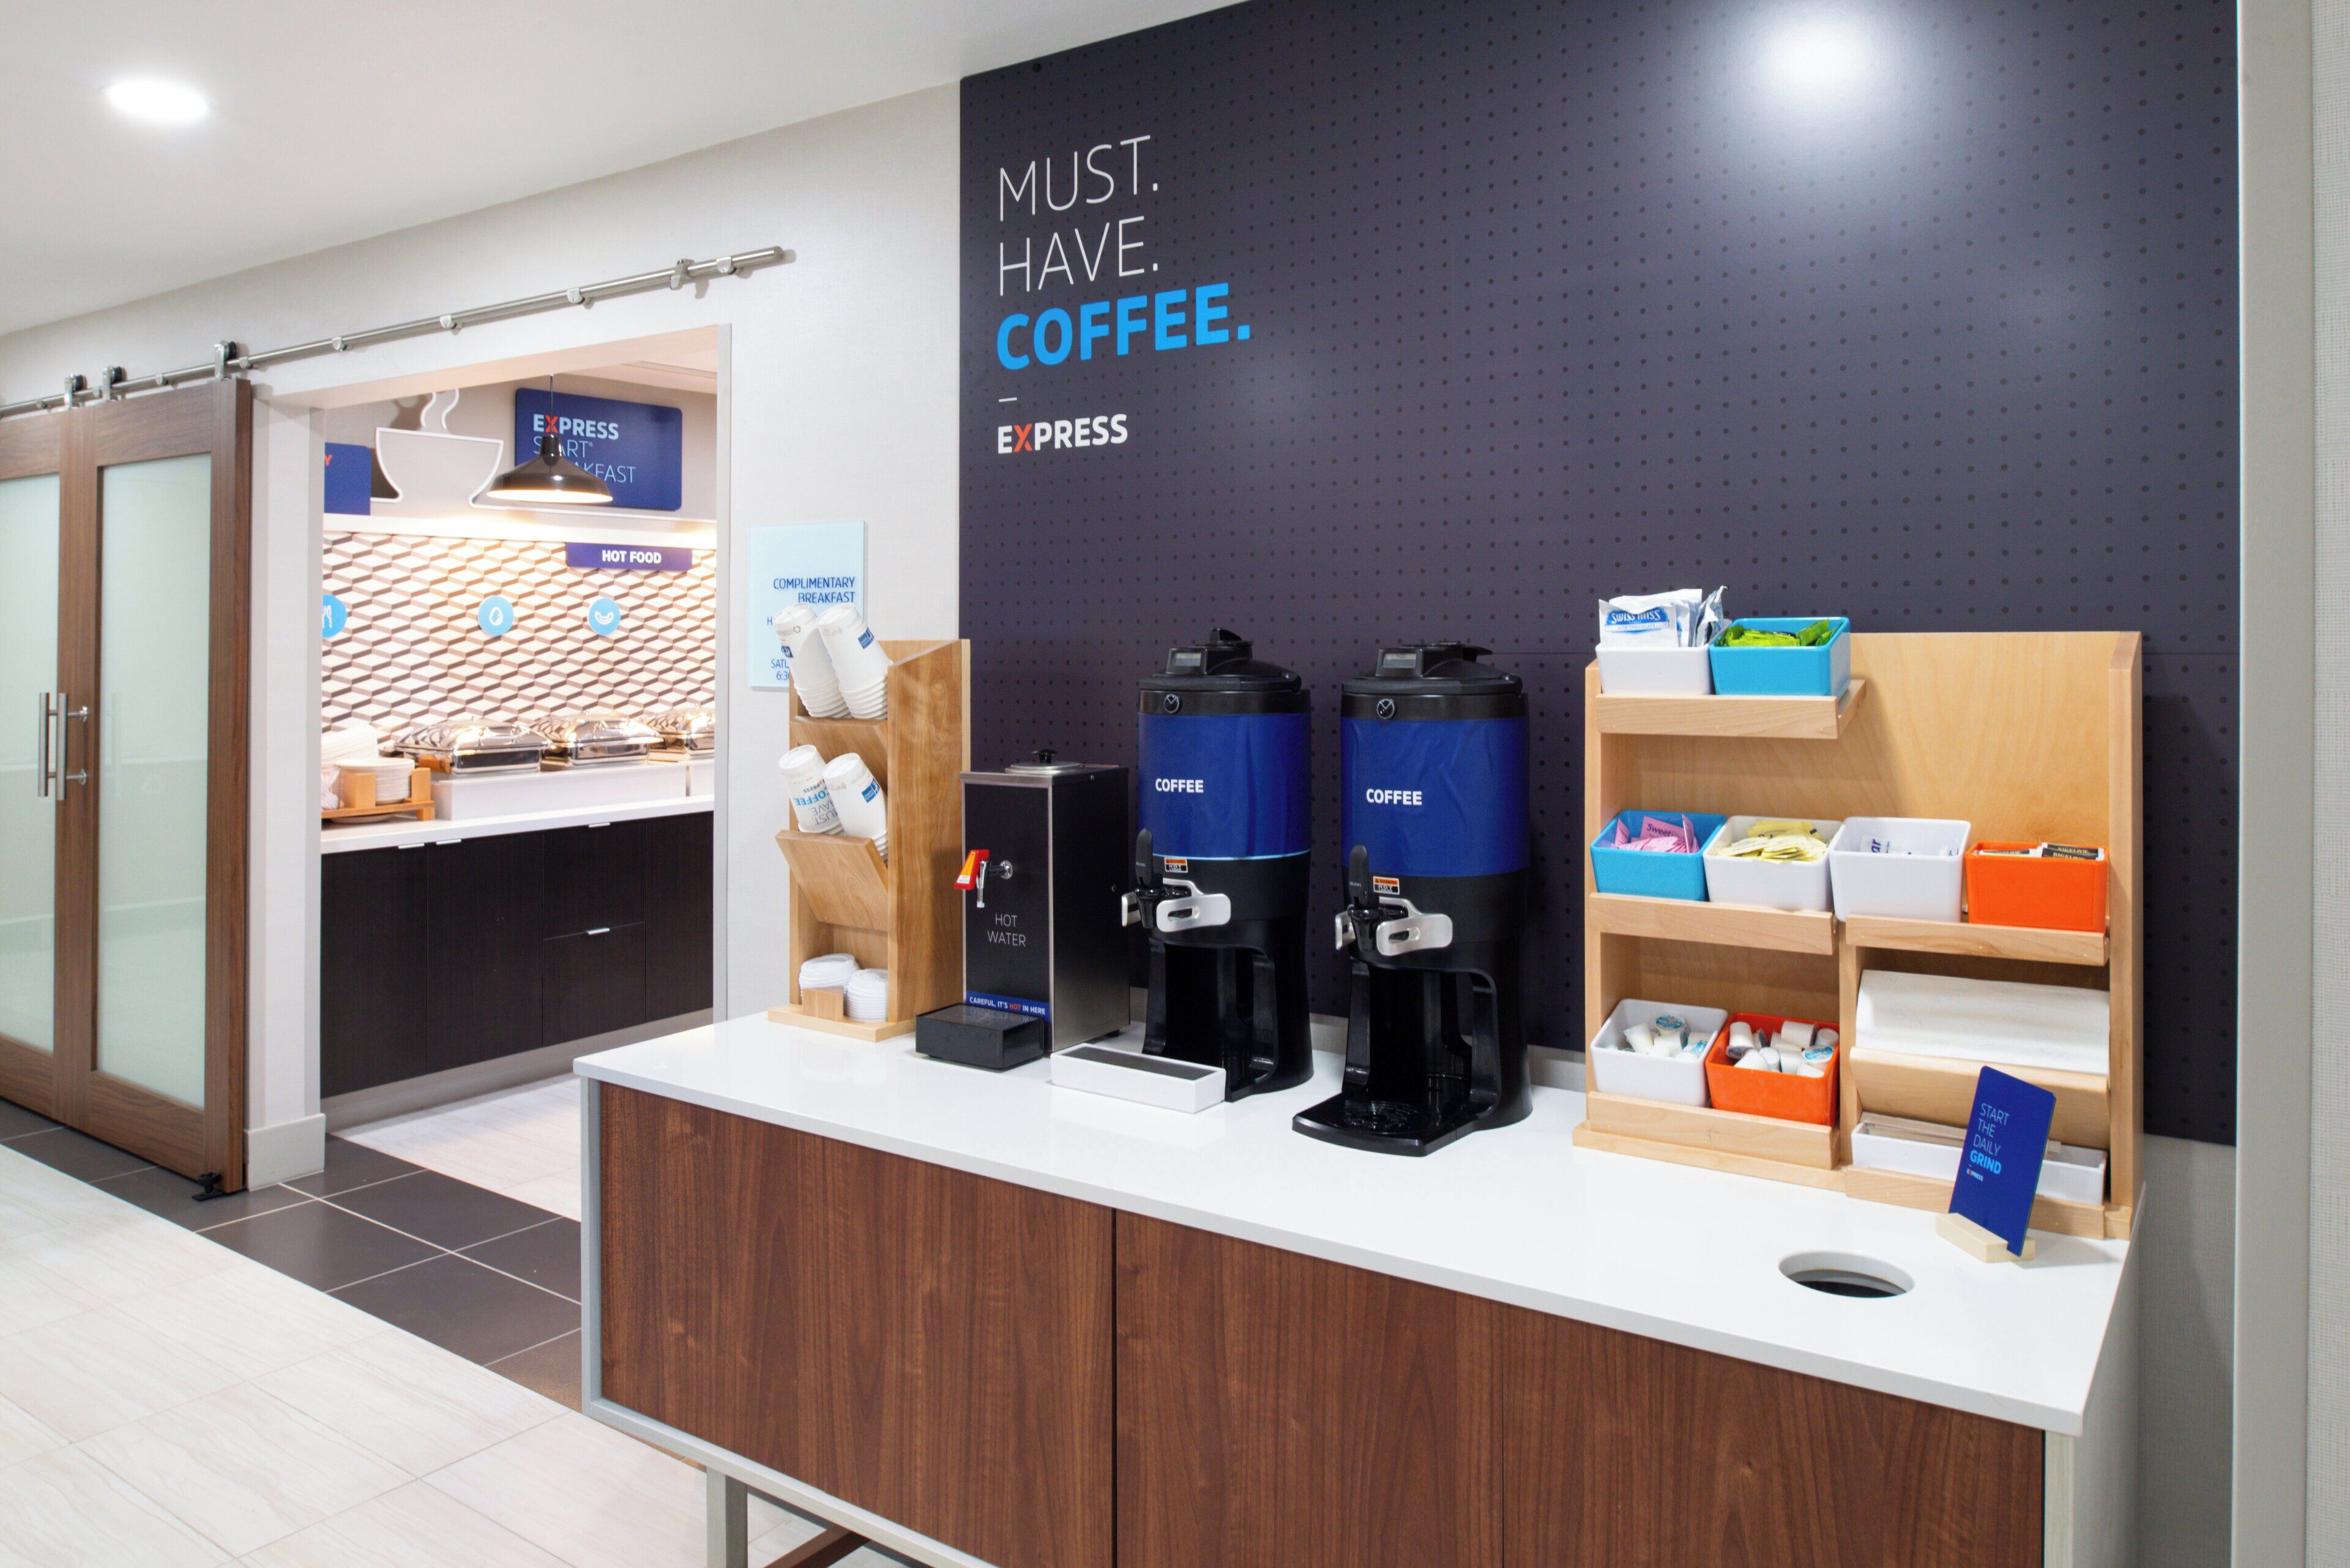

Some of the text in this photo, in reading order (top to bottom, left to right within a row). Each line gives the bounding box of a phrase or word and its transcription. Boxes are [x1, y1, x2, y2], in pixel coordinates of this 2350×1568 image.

[1000, 135, 1158, 222] MUST.
[1000, 215, 1158, 296] HAVE.
[997, 282, 1250, 370] COFFEE.
[533, 414, 619, 440] EXPRESS
[998, 414, 1128, 454] EXPRESS
[602, 550, 662, 564] HOT FOOD
[773, 577, 856, 590] COMPLIMENTARY
[798, 591, 856, 603] BREAKFAST
[1155, 778, 1204, 794] COFFEE
[1366, 788, 1422, 806] COFFEE
[994, 914, 1018, 928] HOT
[987, 930, 1026, 947] WATER
[969, 996, 996, 1007] CAREFUL,
[1030, 1006, 1045, 1015] HERE
[1980, 1103, 2010, 1126] START
[1978, 1118, 1996, 1138] THE
[1973, 1134, 2001, 1156] DAILY
[1970, 1149, 2002, 1174] GRIND
